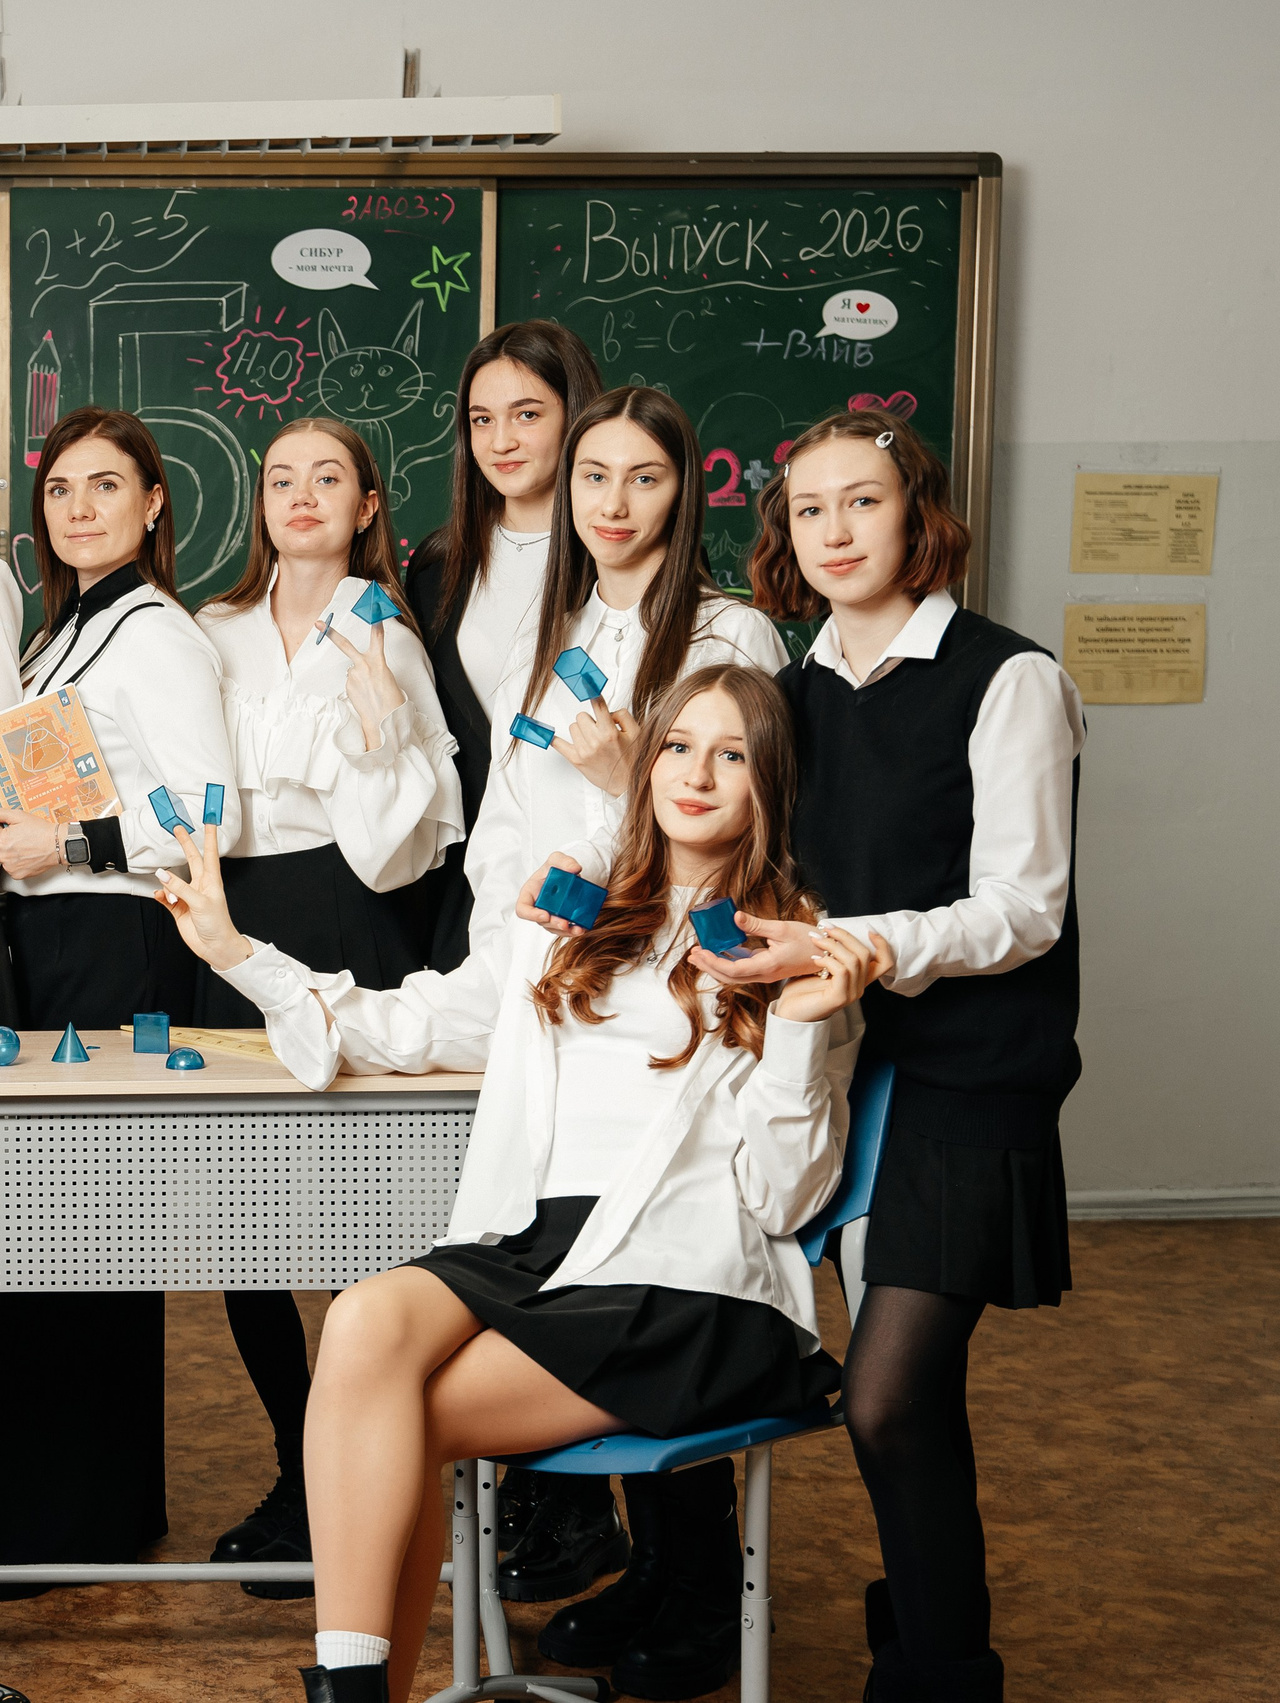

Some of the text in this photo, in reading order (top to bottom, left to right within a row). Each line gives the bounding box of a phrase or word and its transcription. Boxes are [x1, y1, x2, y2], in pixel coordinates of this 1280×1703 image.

[798, 204, 924, 260] 2026
[298, 247, 345, 258] СИБУР
[295, 264, 319, 273] моя
[320, 264, 355, 273] мечта
[841, 298, 852, 310] Я
[833, 316, 889, 328] математику
[76, 756, 97, 773] 11
